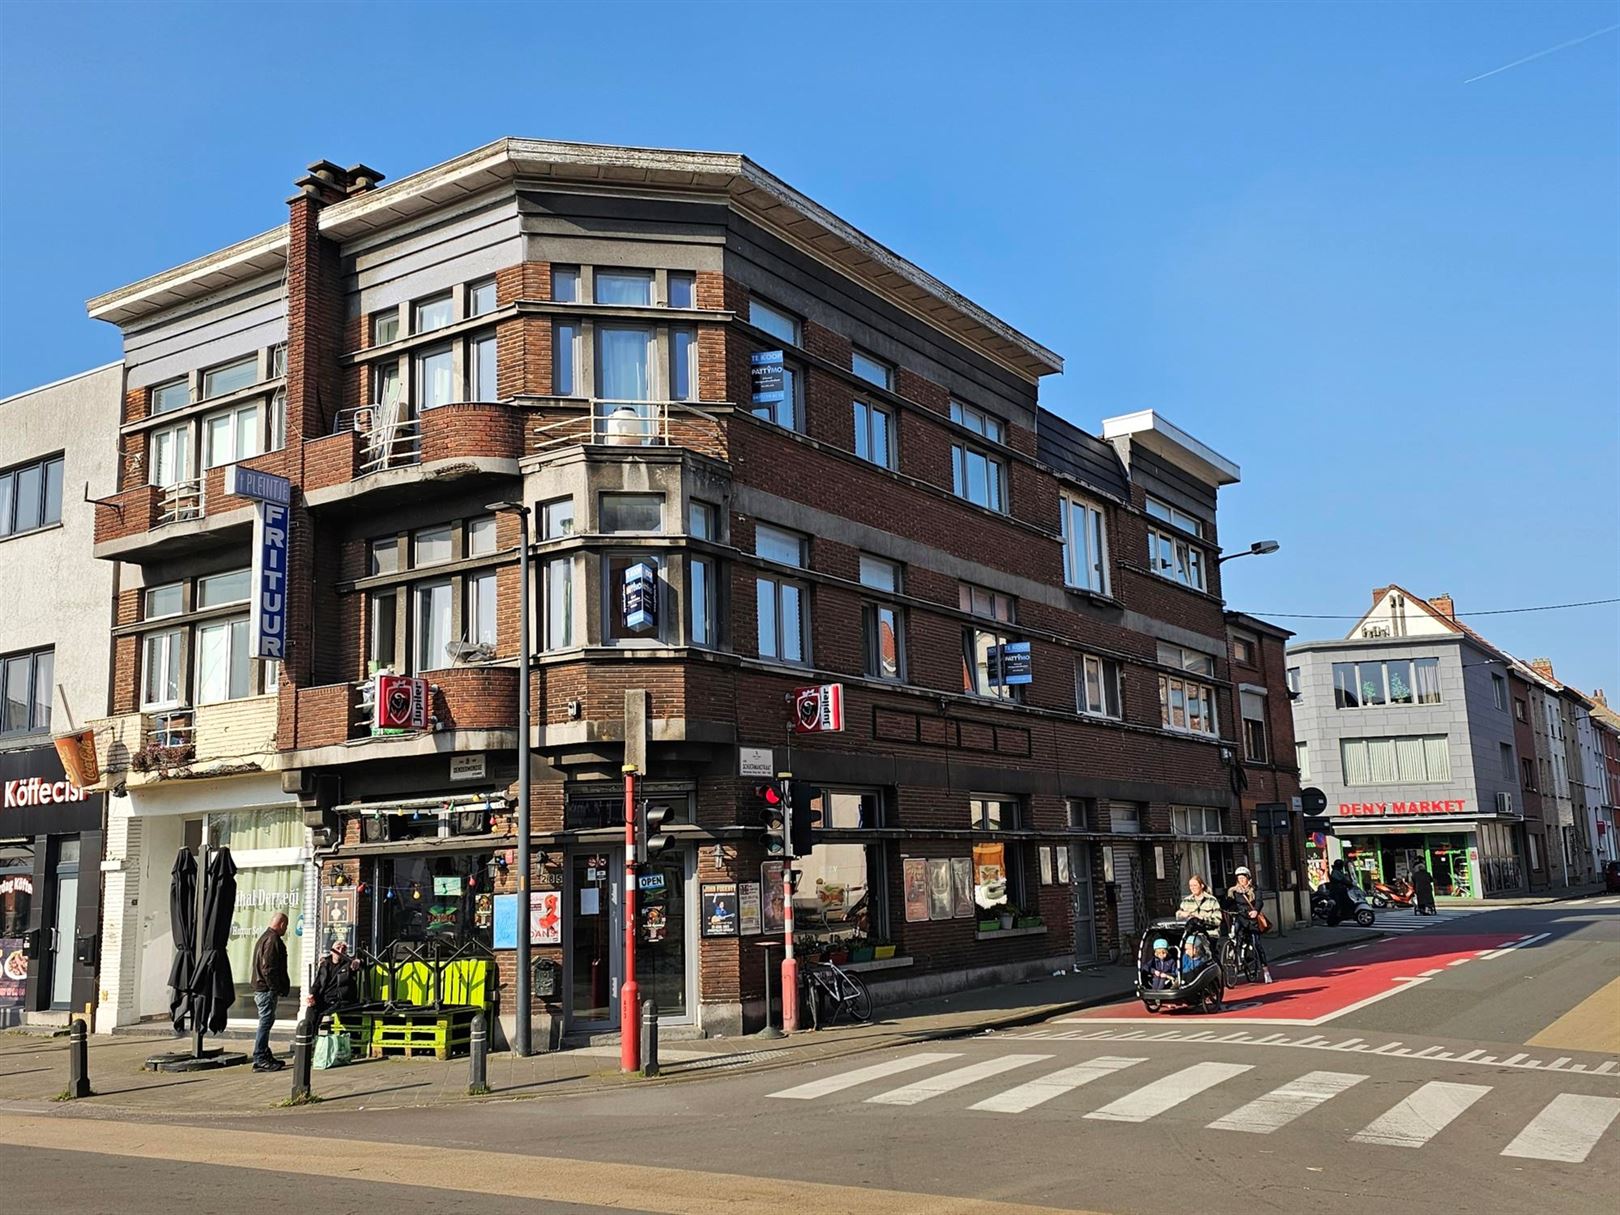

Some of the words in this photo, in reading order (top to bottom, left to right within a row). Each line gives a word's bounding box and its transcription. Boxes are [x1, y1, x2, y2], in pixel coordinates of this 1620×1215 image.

[246, 473, 288, 501] PLEINTJE
[262, 505, 284, 656] FRITUUR
[412, 681, 424, 726] Jupiler
[821, 687, 831, 729] Jupiler
[1339, 801, 1387, 816] DENY
[1391, 800, 1465, 814] MARKET
[641, 876, 664, 887] OPEN
